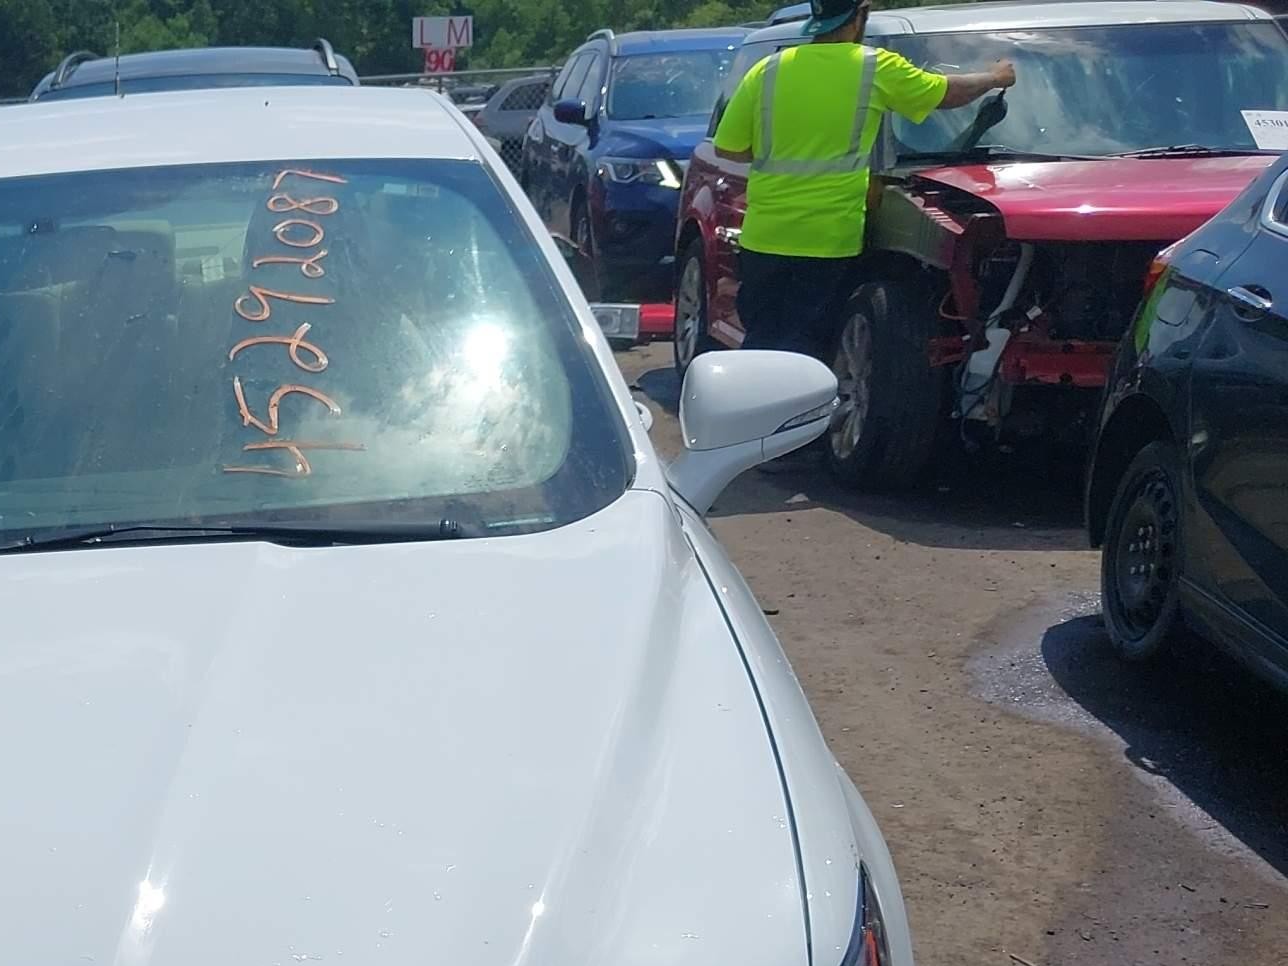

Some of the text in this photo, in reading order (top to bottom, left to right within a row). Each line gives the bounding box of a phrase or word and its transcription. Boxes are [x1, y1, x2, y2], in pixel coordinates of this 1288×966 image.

[420, 17, 470, 46] L M
[223, 169, 368, 476] 45292087
